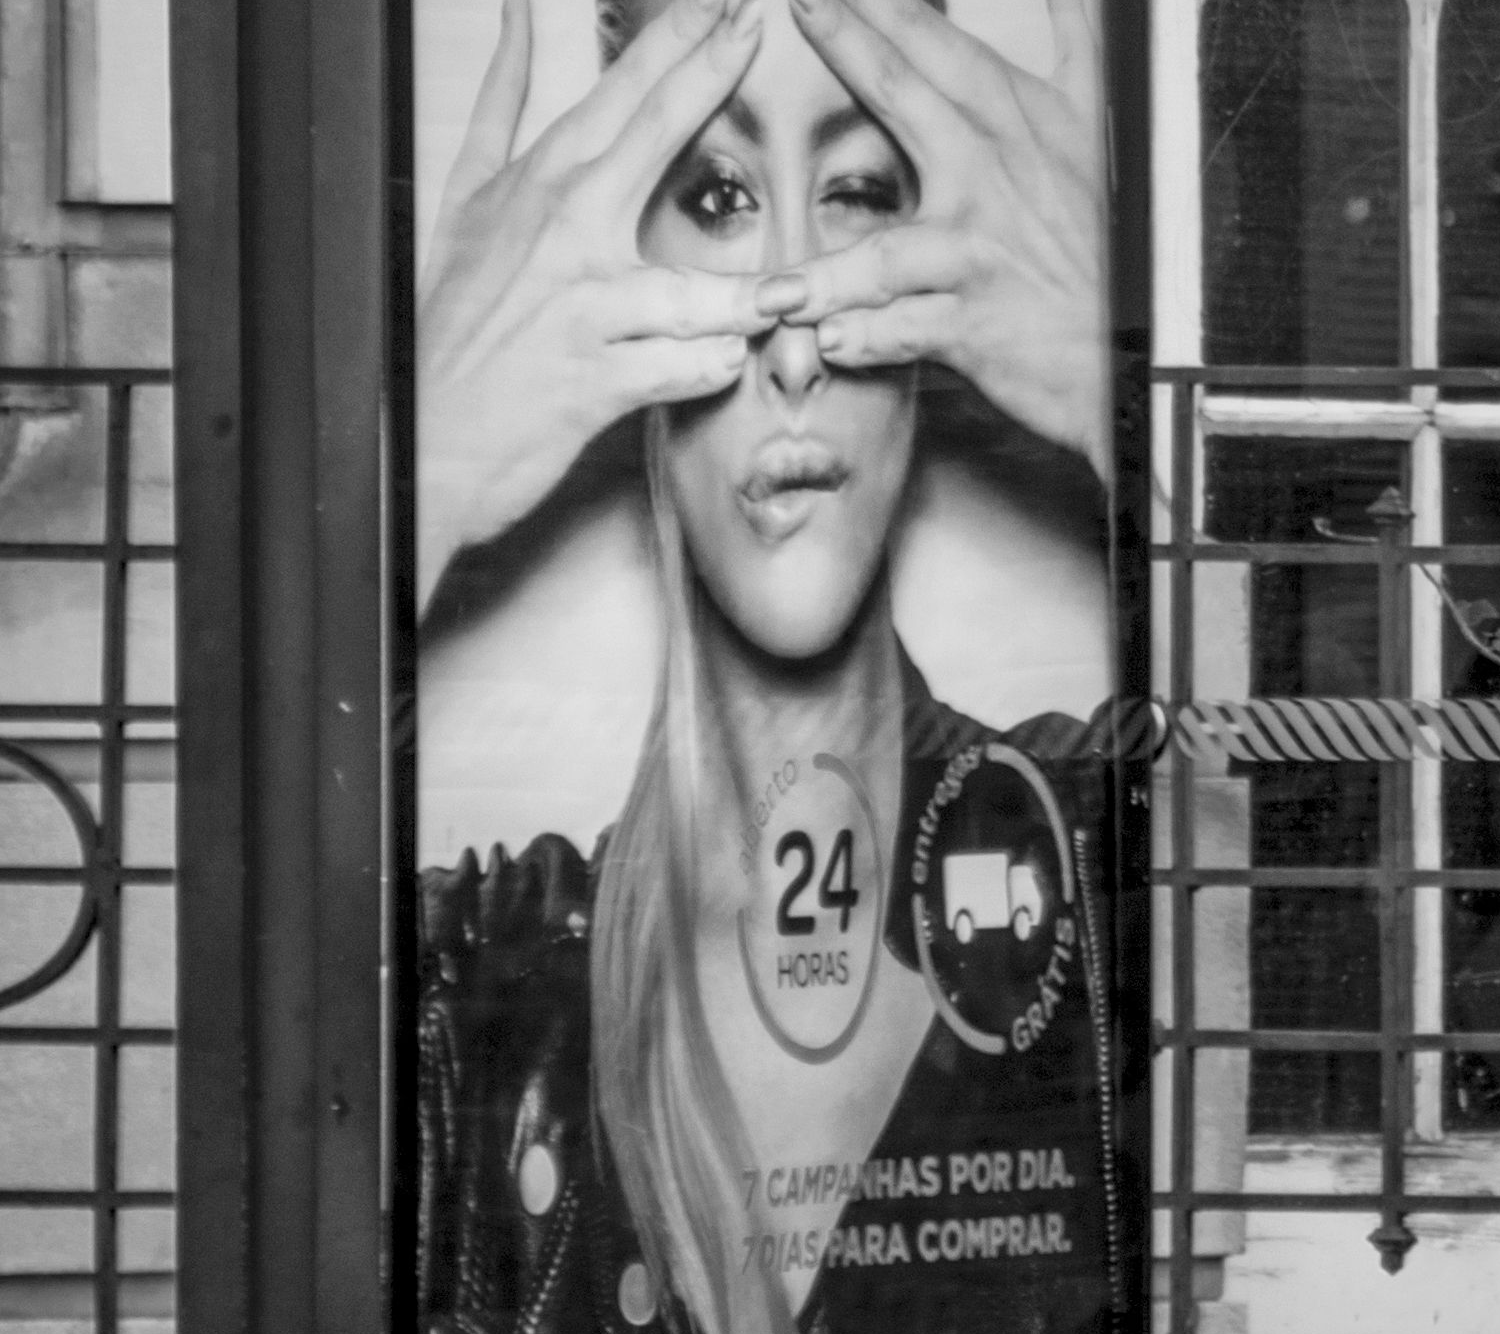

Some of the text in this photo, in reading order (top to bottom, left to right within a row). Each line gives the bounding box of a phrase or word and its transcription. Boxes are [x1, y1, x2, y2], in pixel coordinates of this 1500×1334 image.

[774, 828, 859, 937] 24
[776, 951, 850, 990] HORAS
[766, 1155, 943, 1208] CAMPANHAS
[949, 1150, 1013, 1195] POR
[757, 1229, 821, 1274] DIAS
[826, 1223, 912, 1269] PARA
